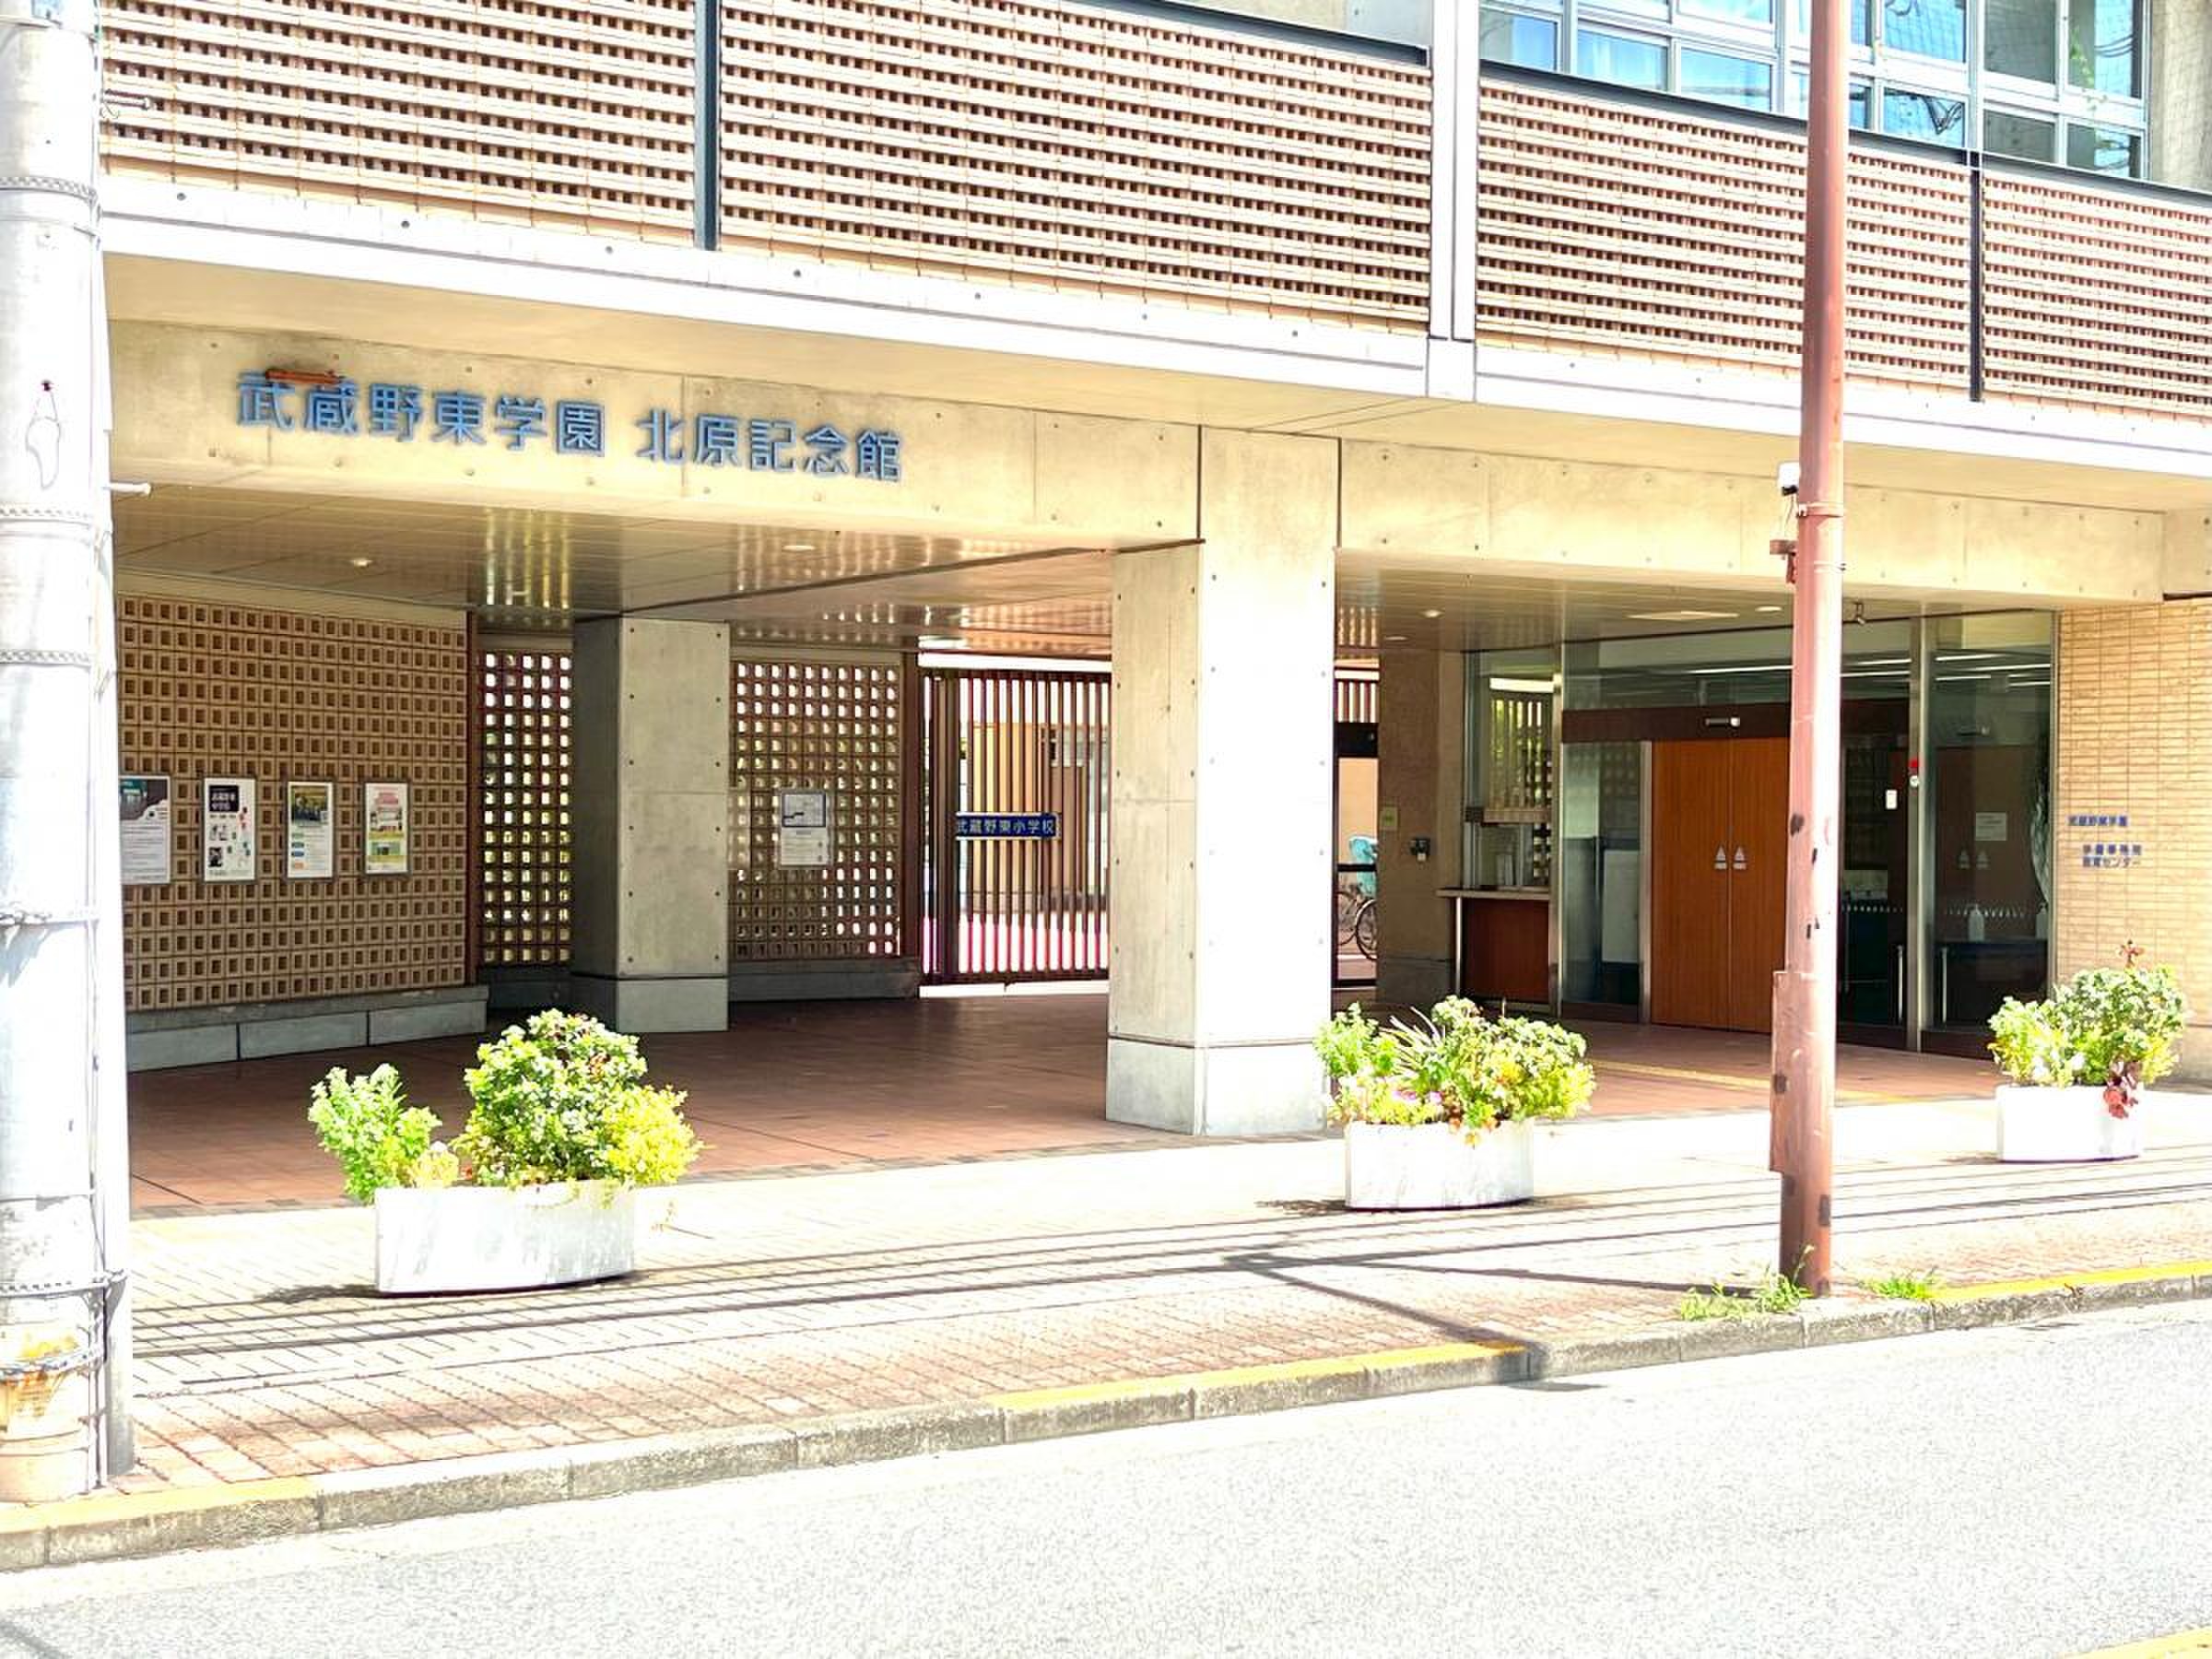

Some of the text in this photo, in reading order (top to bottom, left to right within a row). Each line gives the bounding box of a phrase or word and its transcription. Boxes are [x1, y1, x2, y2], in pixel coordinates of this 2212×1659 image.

[237, 371, 902, 482] 武蔵野東学園 北原記念館
